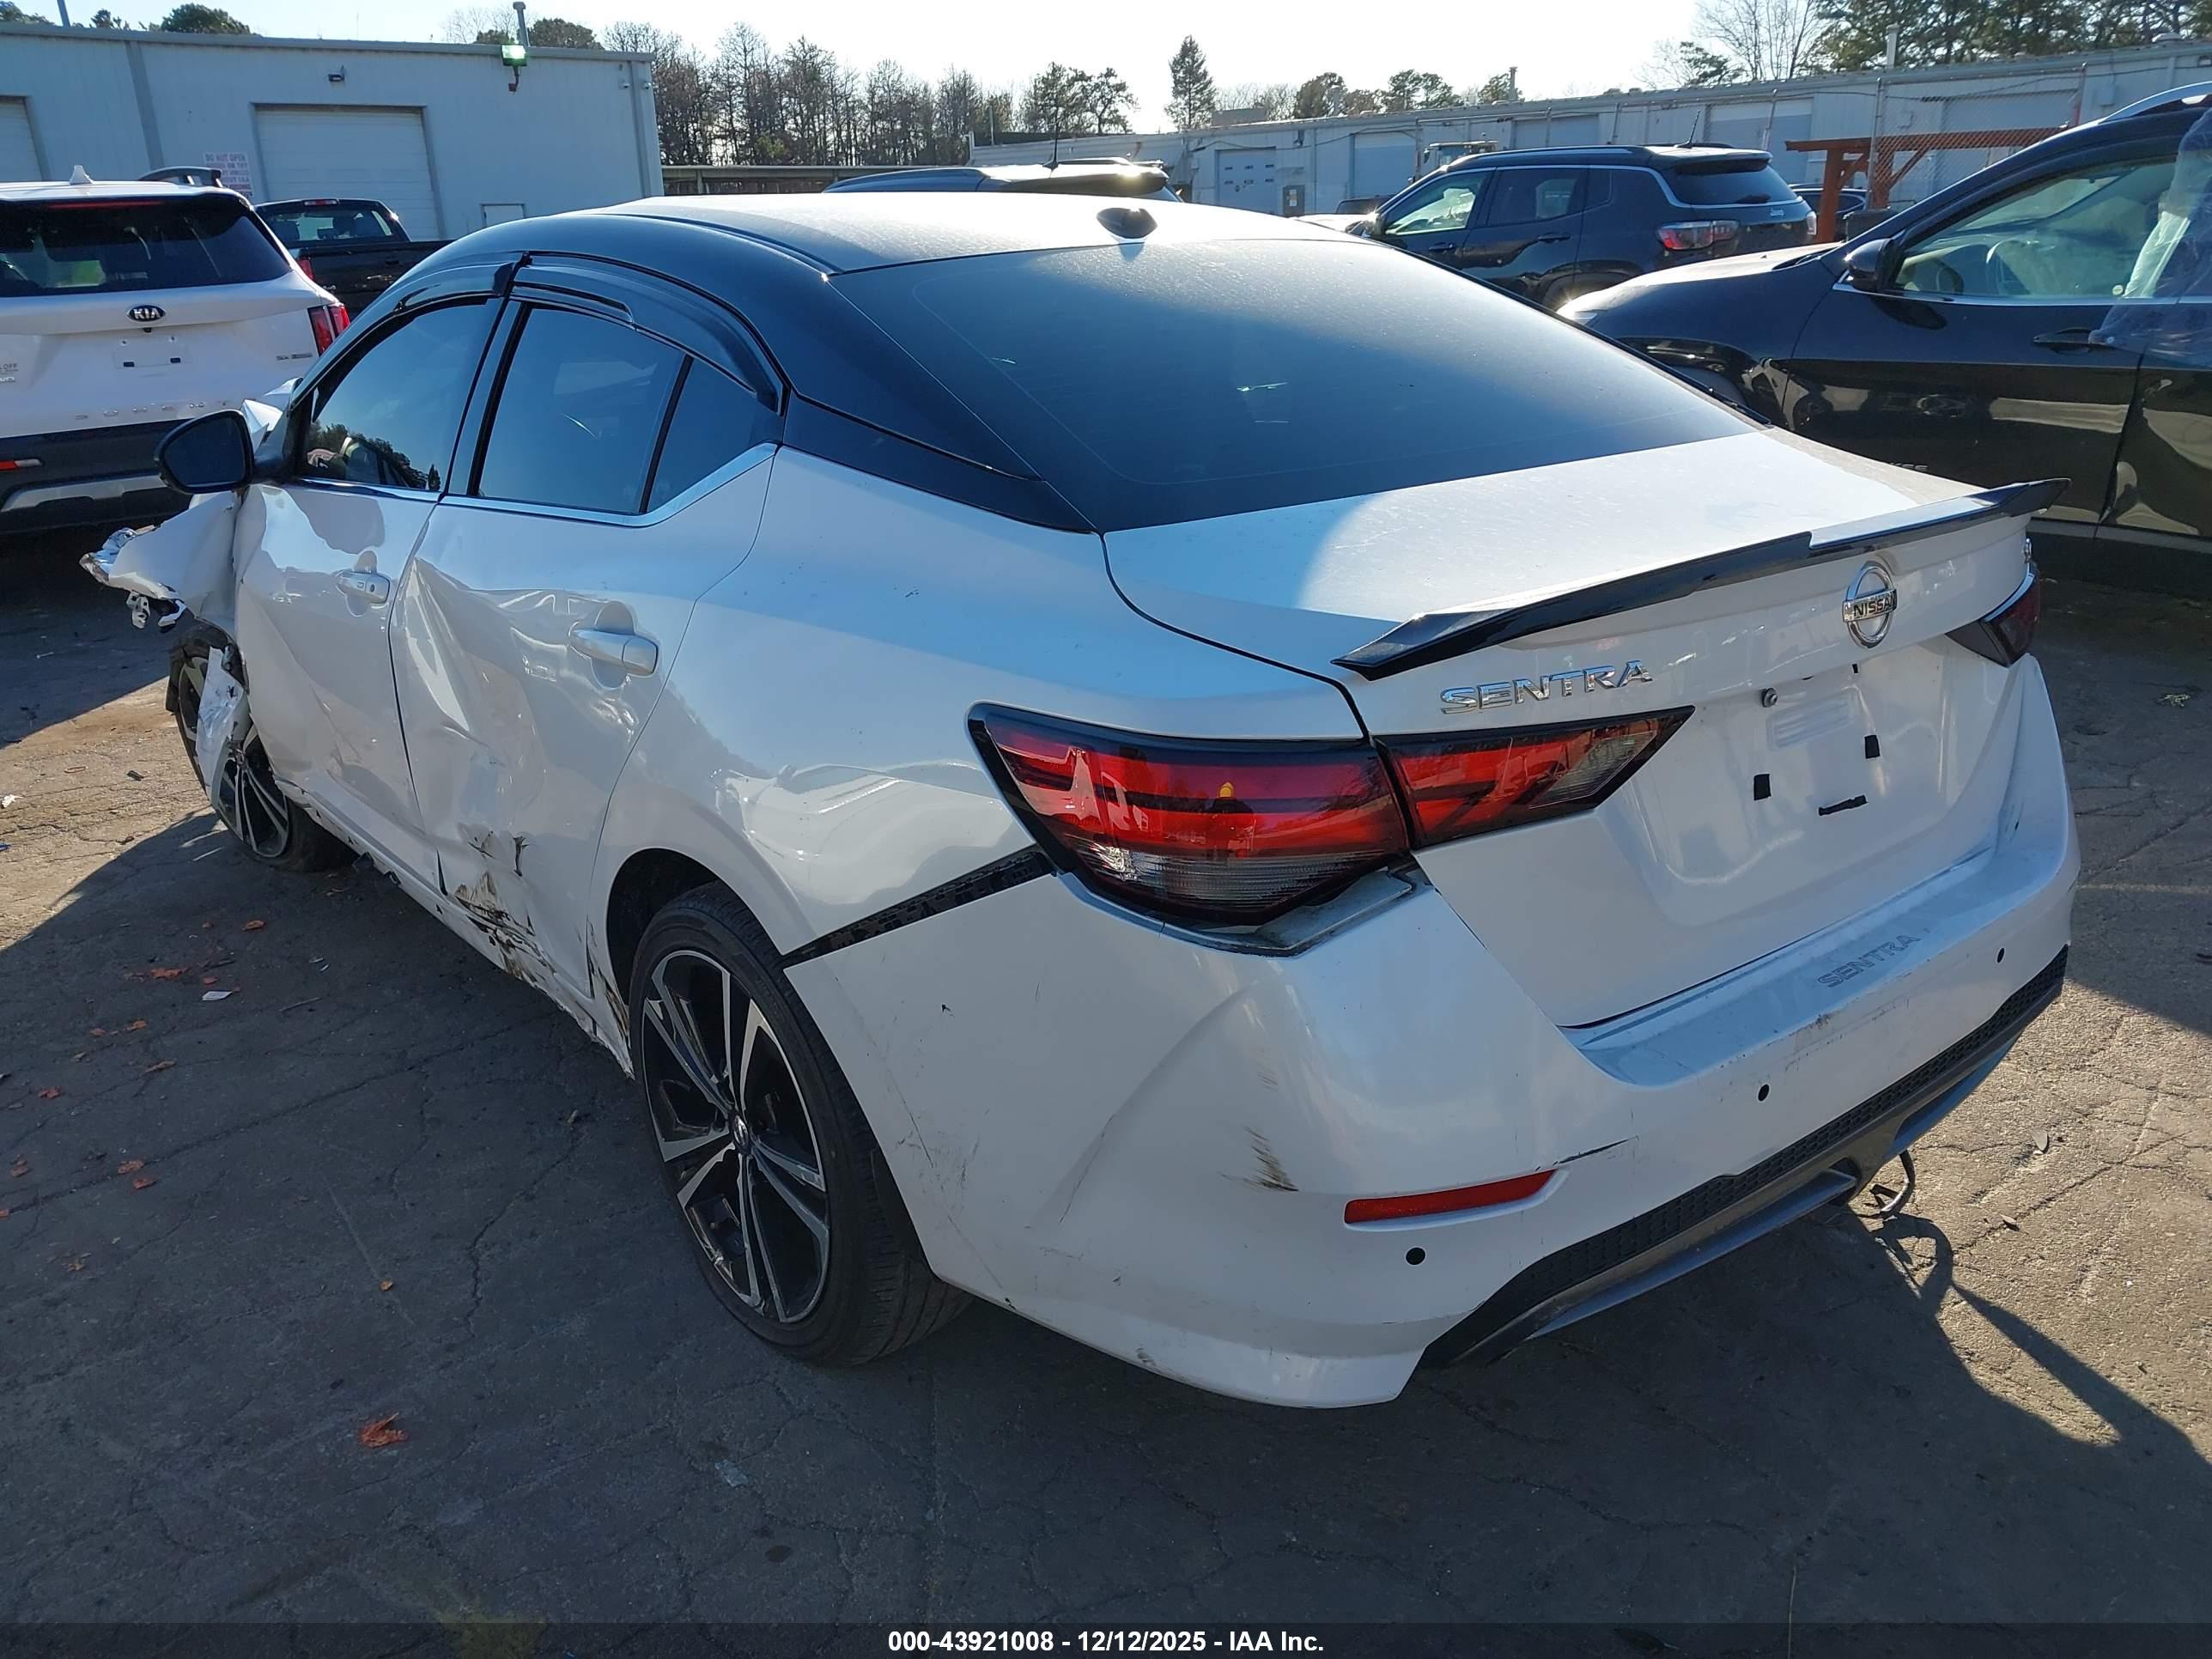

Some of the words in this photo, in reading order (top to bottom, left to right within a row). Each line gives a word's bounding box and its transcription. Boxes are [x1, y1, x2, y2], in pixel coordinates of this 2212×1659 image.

[133, 307, 161, 319] KIA
[1440, 659, 1654, 714] SENTRA
[1817, 935, 1922, 988] SENTRA
